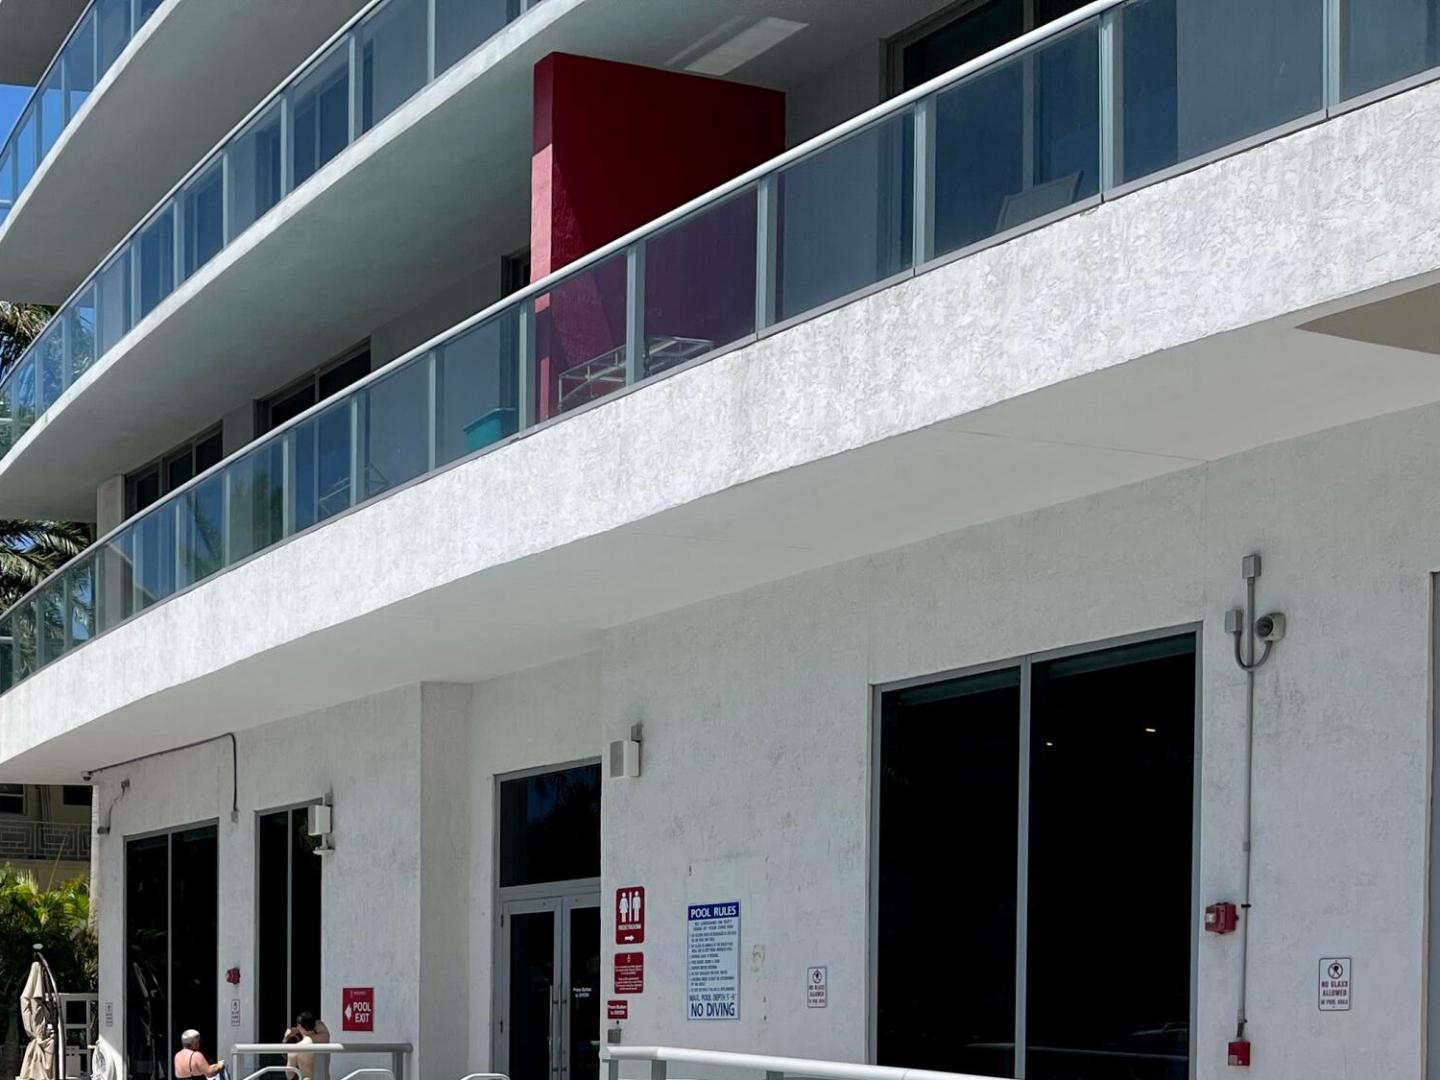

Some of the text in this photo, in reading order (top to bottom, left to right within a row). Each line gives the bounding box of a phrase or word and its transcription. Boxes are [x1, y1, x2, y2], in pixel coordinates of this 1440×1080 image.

[691, 905, 736, 918] POOL RULES
[353, 1002, 371, 1012] POOL
[691, 1002, 735, 1017] NO DIVING
[355, 1013, 370, 1023] EXIT
